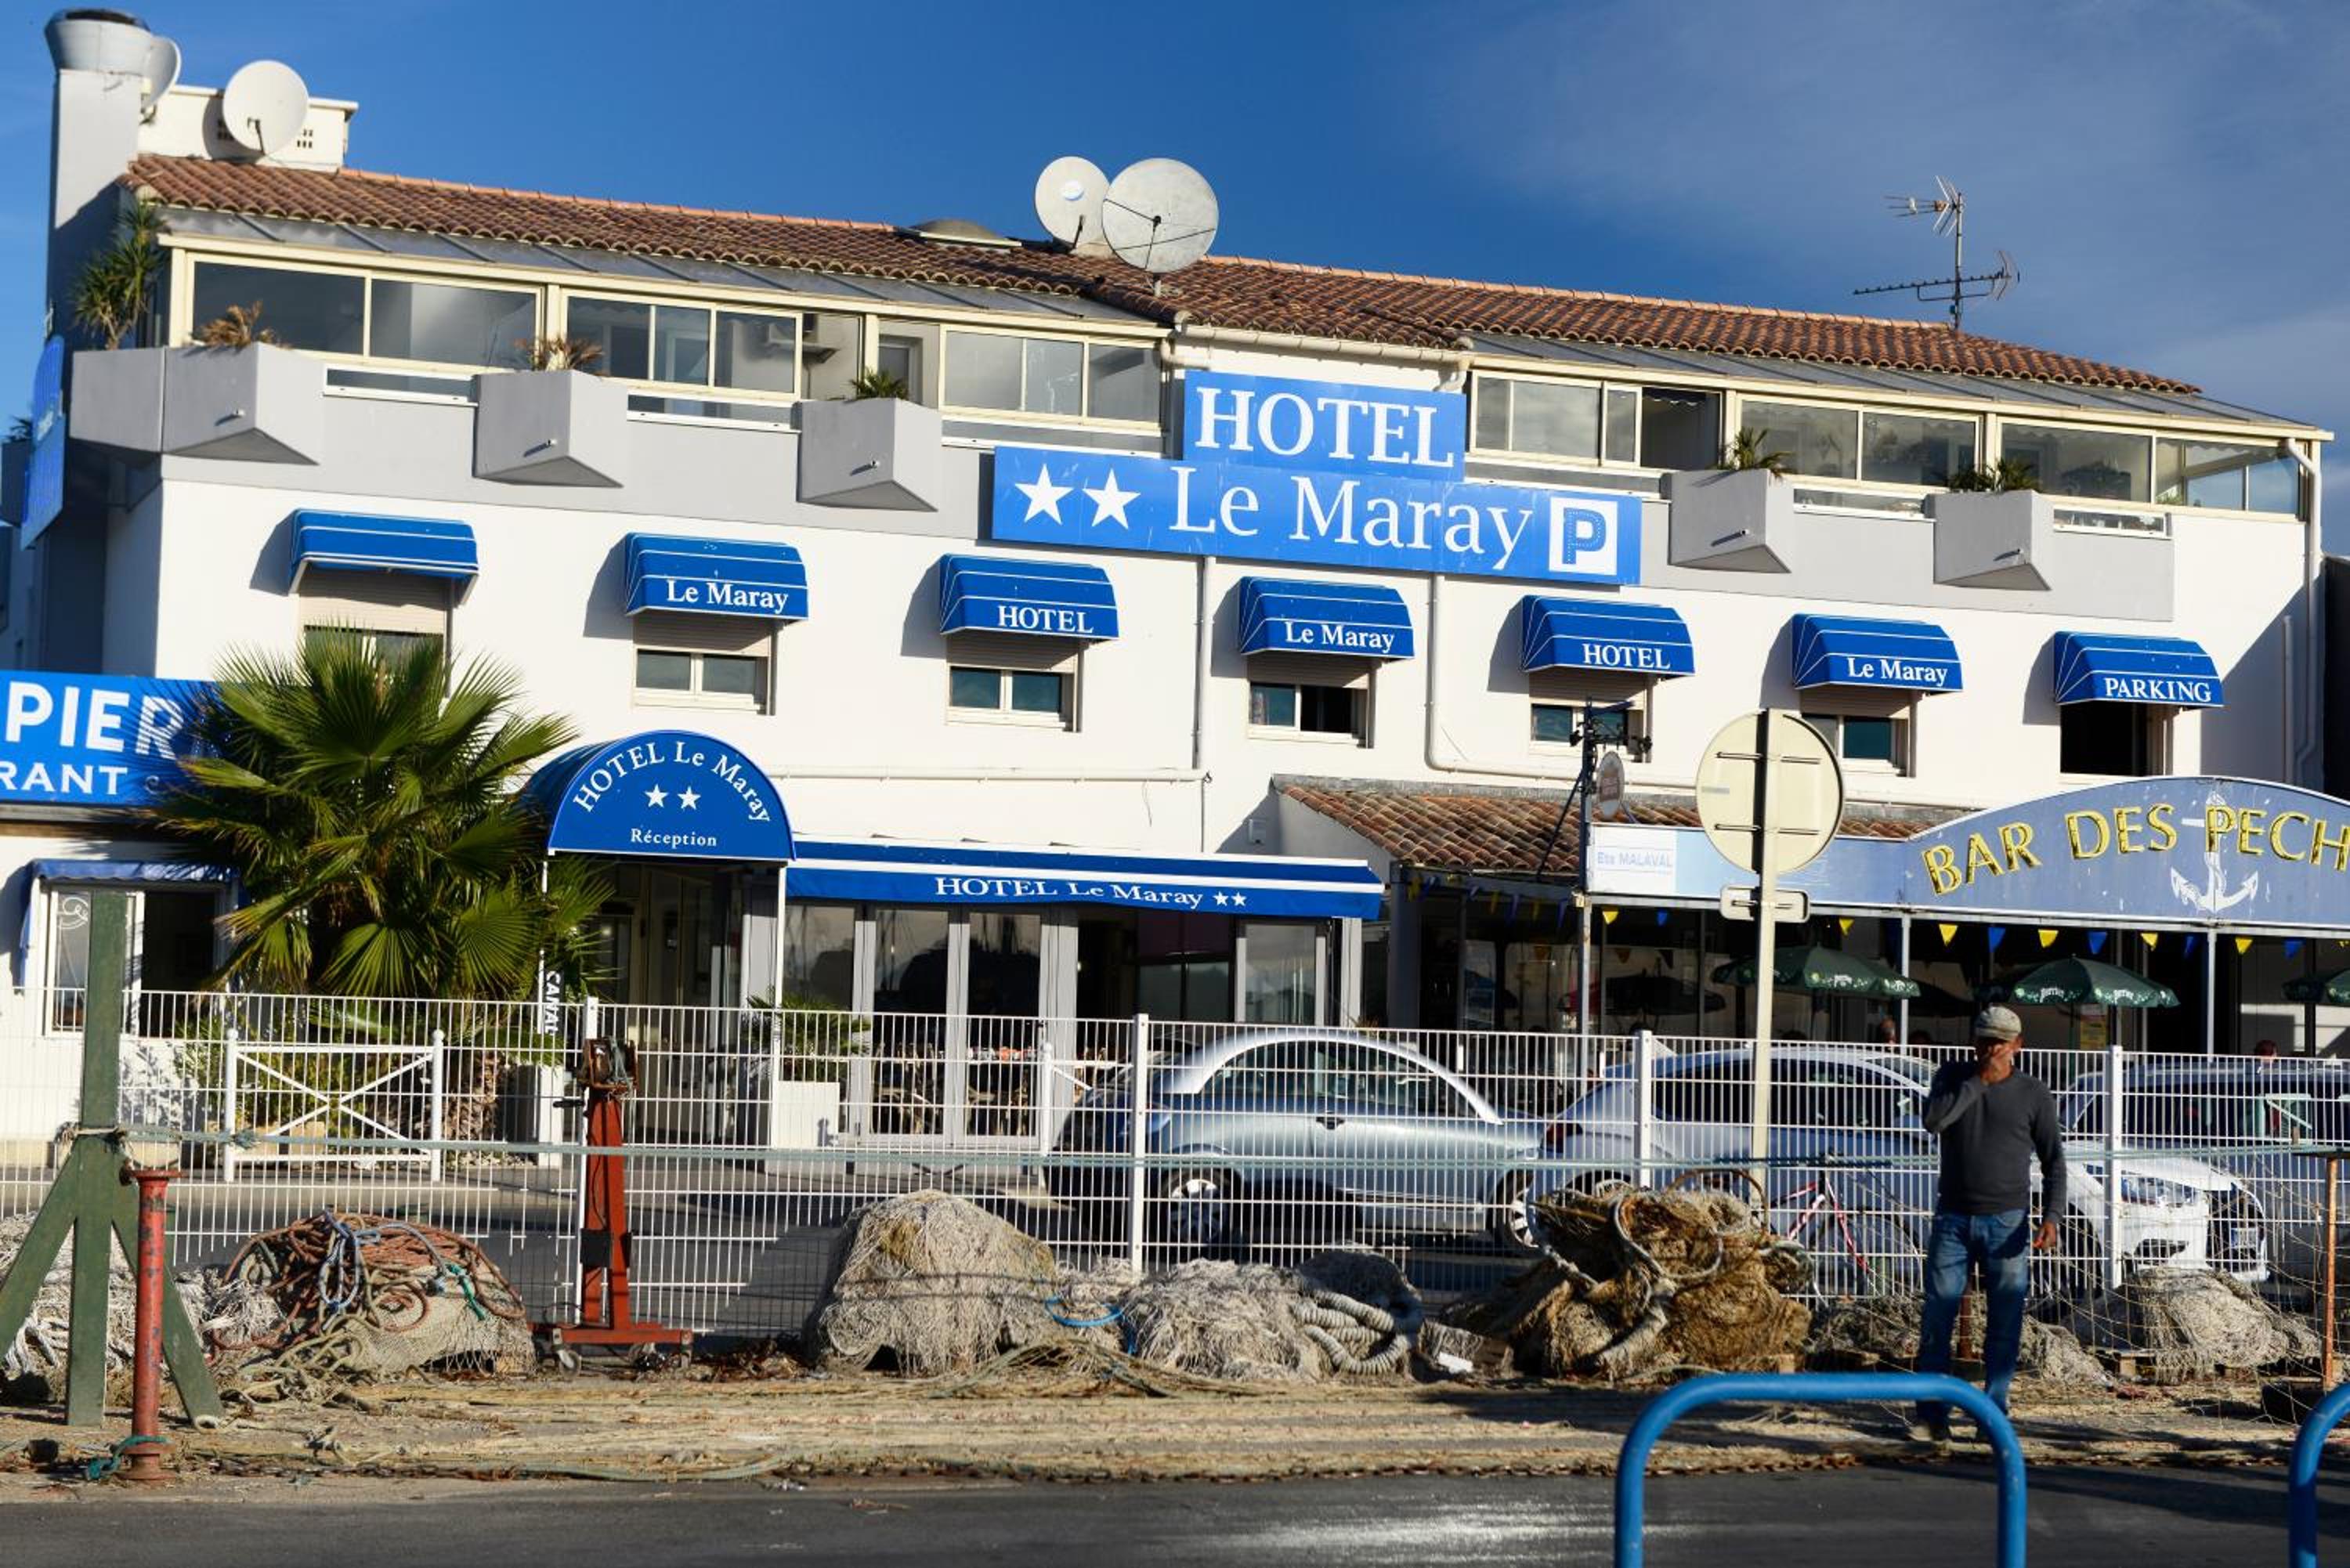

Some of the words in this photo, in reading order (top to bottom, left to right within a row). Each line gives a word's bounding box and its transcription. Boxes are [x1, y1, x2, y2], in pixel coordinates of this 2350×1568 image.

[1195, 385, 1455, 468] HOTEL
[1169, 465, 1260, 537] Le
[1290, 475, 1533, 571] Maray
[1561, 508, 1608, 568] P
[666, 579, 699, 603] Le
[705, 581, 789, 613] Maray
[996, 604, 1094, 634] HOTEL
[1285, 621, 1314, 645] Le
[1321, 623, 1395, 652] Maray
[1582, 643, 1671, 670] HOTEL
[1846, 657, 1875, 678] Le
[1880, 659, 1948, 686] Maray
[2104, 677, 2212, 703] PARKING
[573, 742, 665, 812] HOTEL
[674, 741, 706, 767] Le
[710, 754, 771, 823] Maray
[630, 827, 718, 849] Réception
[1922, 821, 2043, 896] BAR
[2063, 802, 2178, 861] DES
[2203, 803, 2350, 872] PECH
[935, 877, 1058, 897] HOTEL
[1068, 880, 1105, 898] Le
[1110, 883, 1204, 909] Maray
